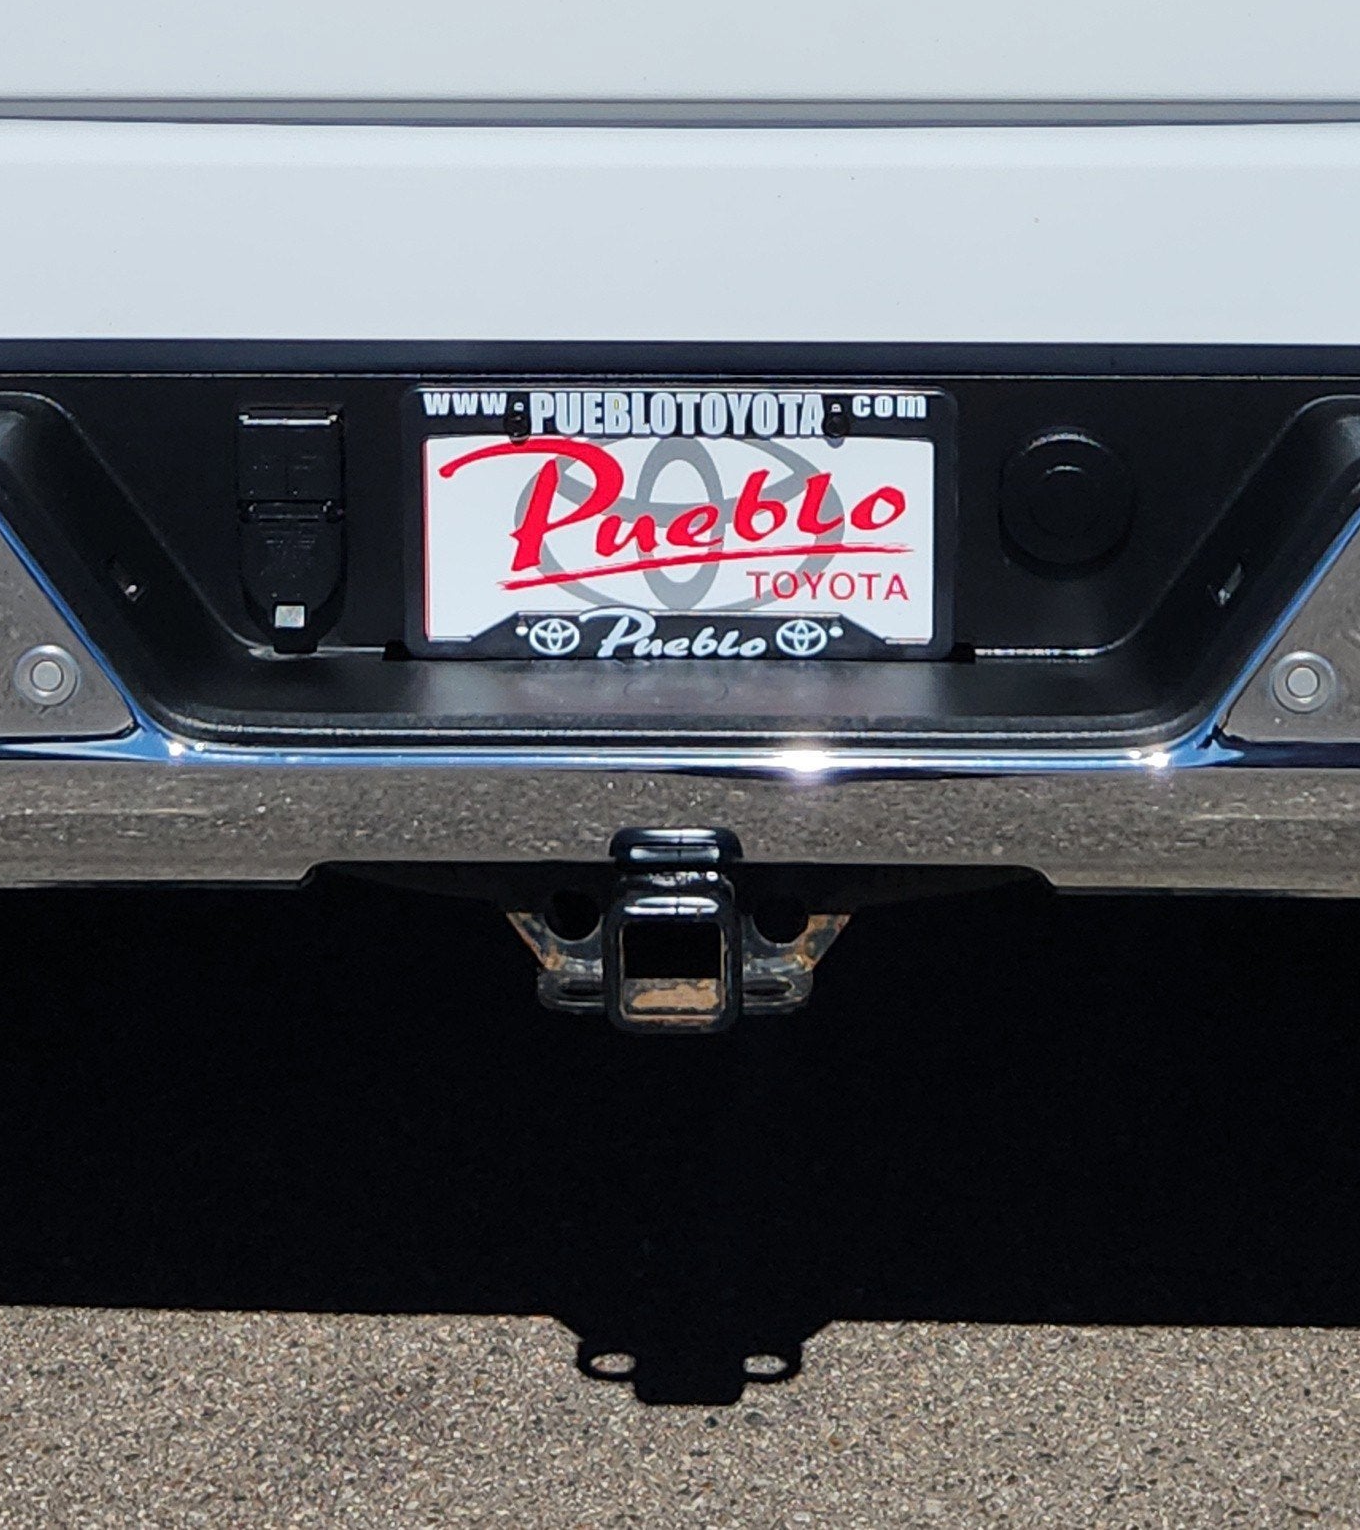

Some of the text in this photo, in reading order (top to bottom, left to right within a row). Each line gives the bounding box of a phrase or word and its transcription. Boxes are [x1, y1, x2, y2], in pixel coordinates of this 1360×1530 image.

[439, 438, 907, 571] Pueblo
[746, 571, 910, 601] TOYOTA
[578, 606, 768, 658] Pueblo
